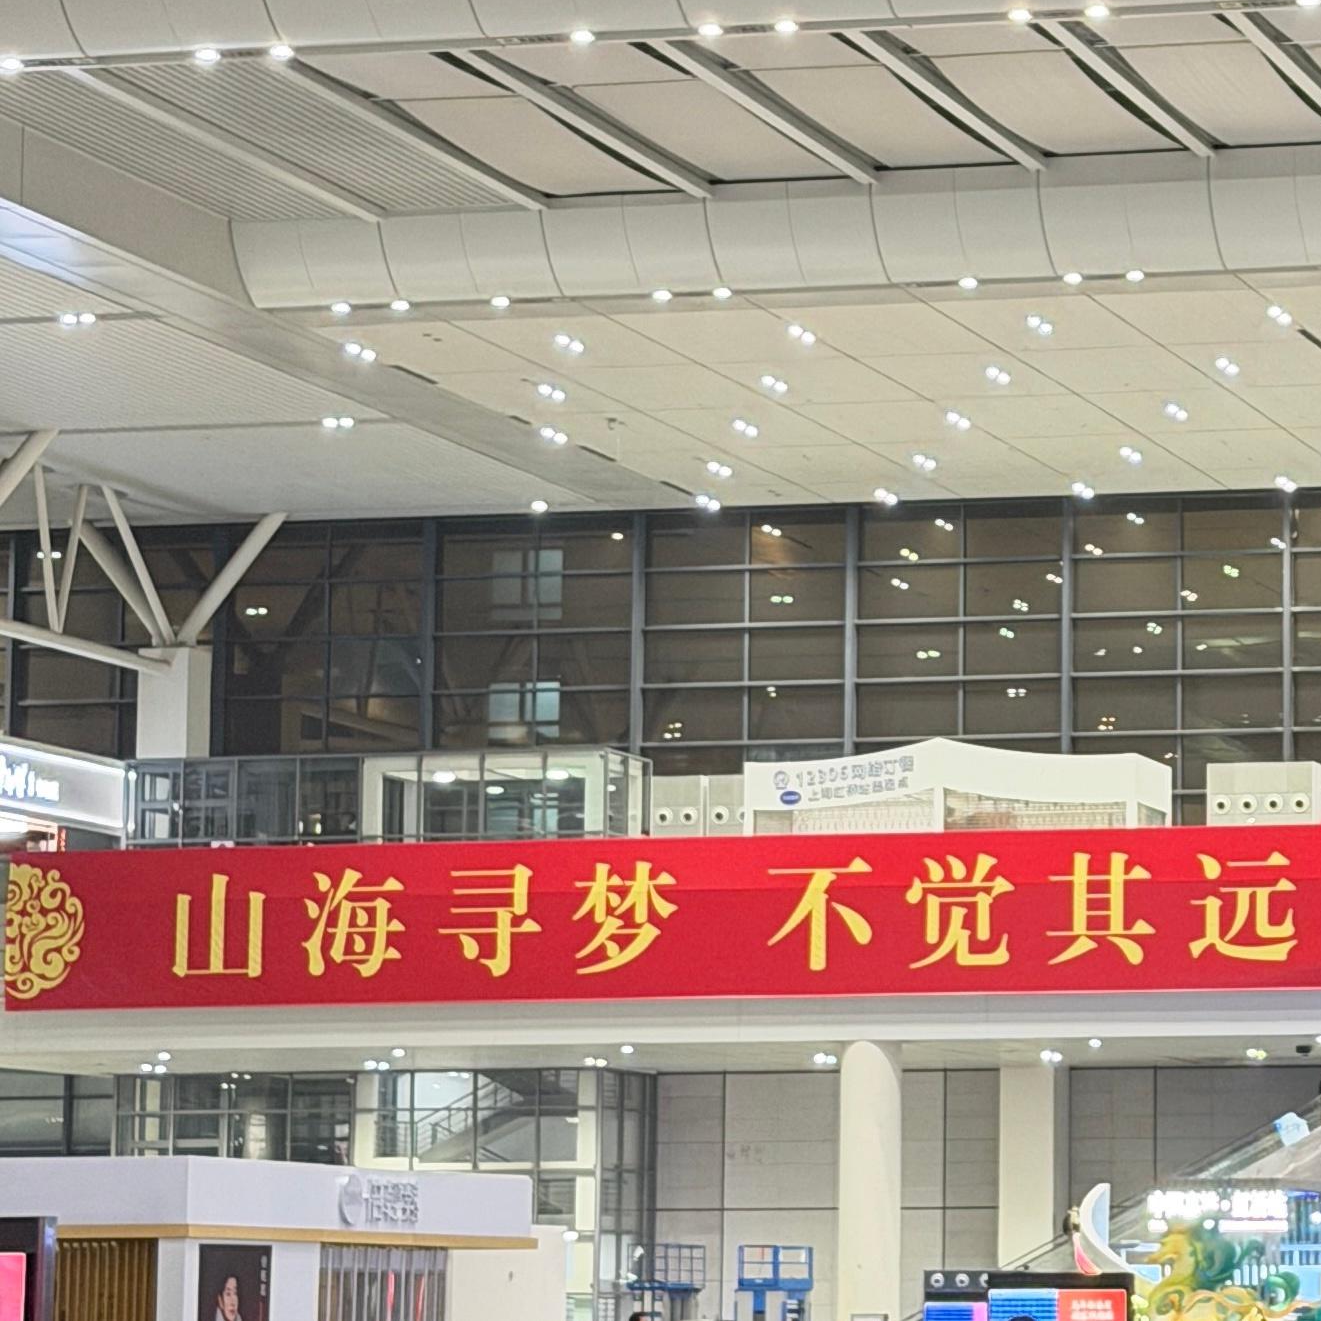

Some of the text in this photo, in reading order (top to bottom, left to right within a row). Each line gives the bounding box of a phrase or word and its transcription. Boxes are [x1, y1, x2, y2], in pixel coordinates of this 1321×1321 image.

[172, 862, 679, 977] 山海寻梦
[767, 851, 1298, 971] 不觉其远
